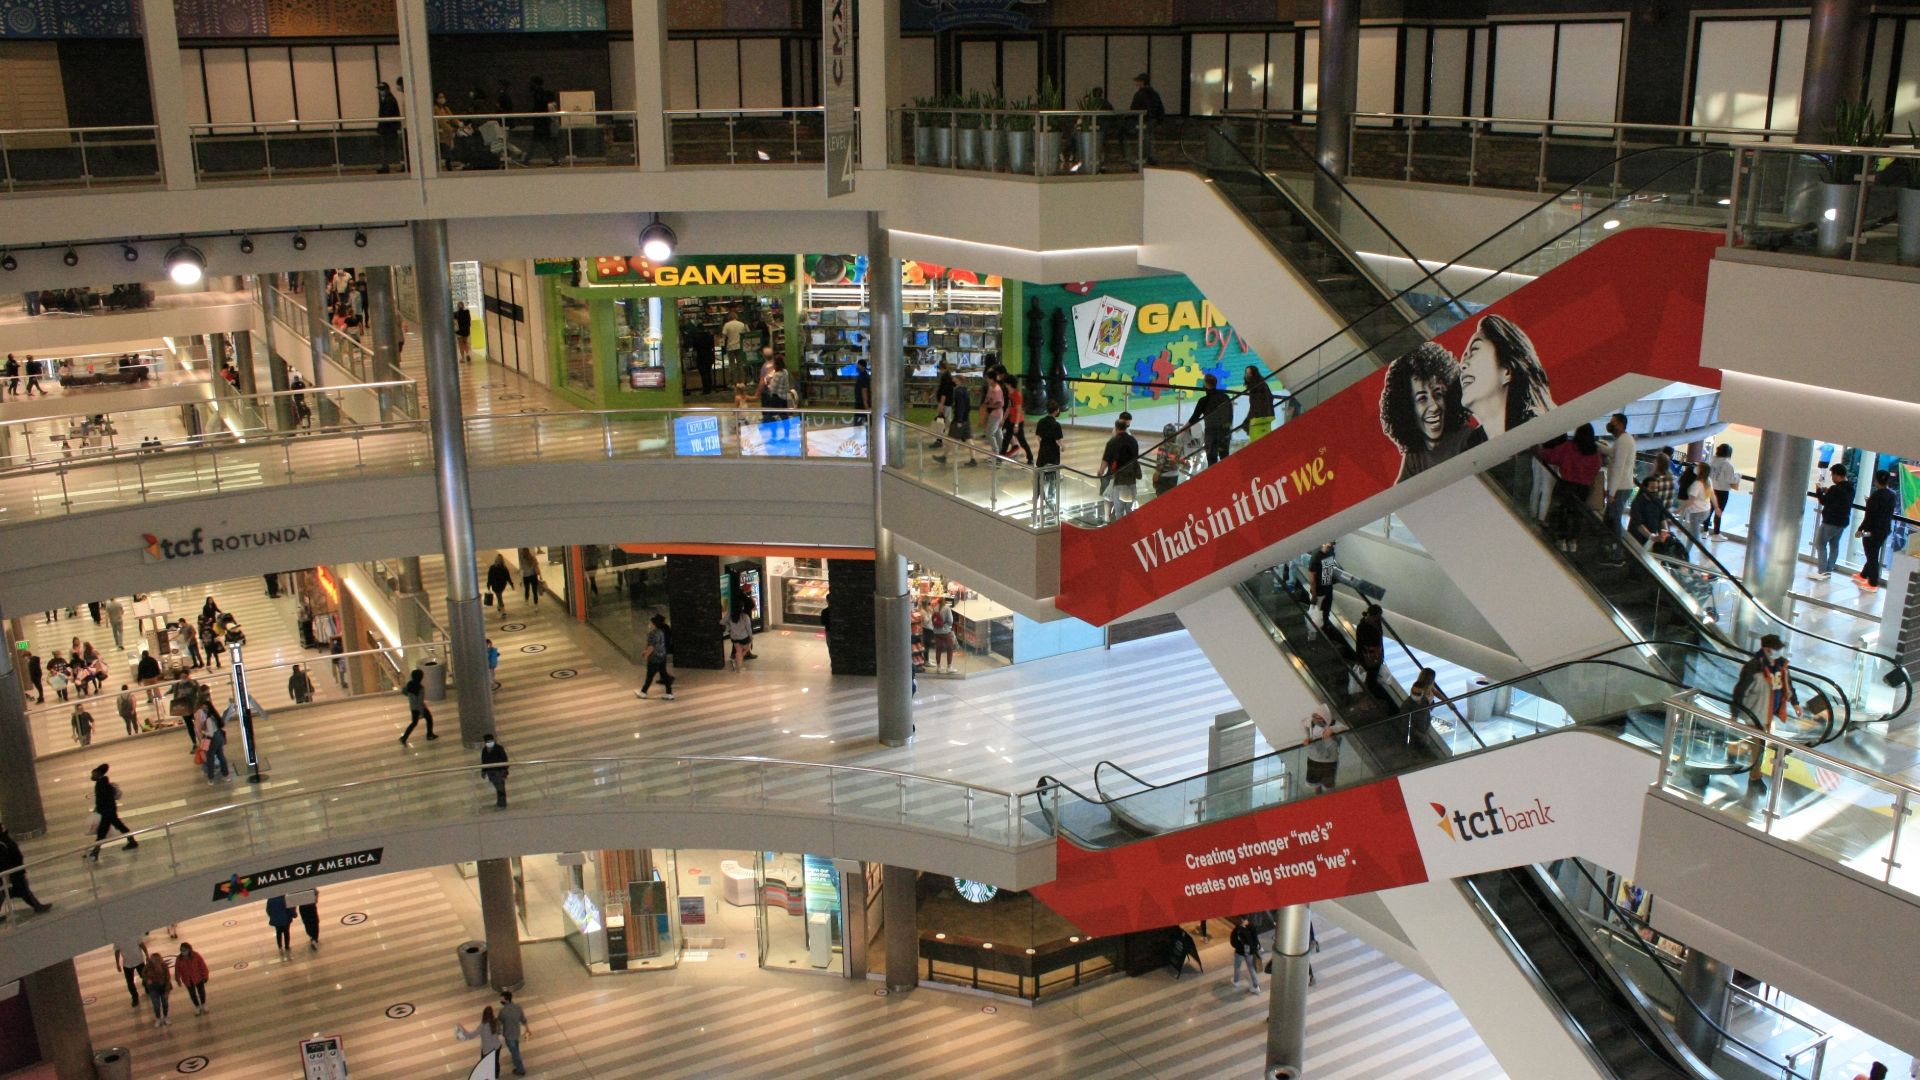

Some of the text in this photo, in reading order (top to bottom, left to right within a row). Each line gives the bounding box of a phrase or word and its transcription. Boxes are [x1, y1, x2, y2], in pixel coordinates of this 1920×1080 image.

[828, 135, 847, 152] LEVEL
[841, 135, 855, 192] 4
[654, 263, 786, 286] GAMES
[1205, 304, 1232, 361] by
[1131, 513, 1210, 573] What’s
[1206, 506, 1236, 539] in
[1232, 491, 1255, 527] it
[1251, 476, 1289, 517] for
[1290, 456, 1335, 496] we.
[161, 527, 310, 559] tcf ROTUNDA
[1453, 791, 1555, 842] tcf bank
[257, 852, 375, 886] MALL OF AMERICA
[1185, 847, 1237, 870] Creating
[1237, 835, 1289, 859] stronger
[1184, 877, 1226, 897] creates
[1227, 873, 1250, 889] one
[1250, 865, 1273, 886] big
[1274, 859, 1317, 878] strong
